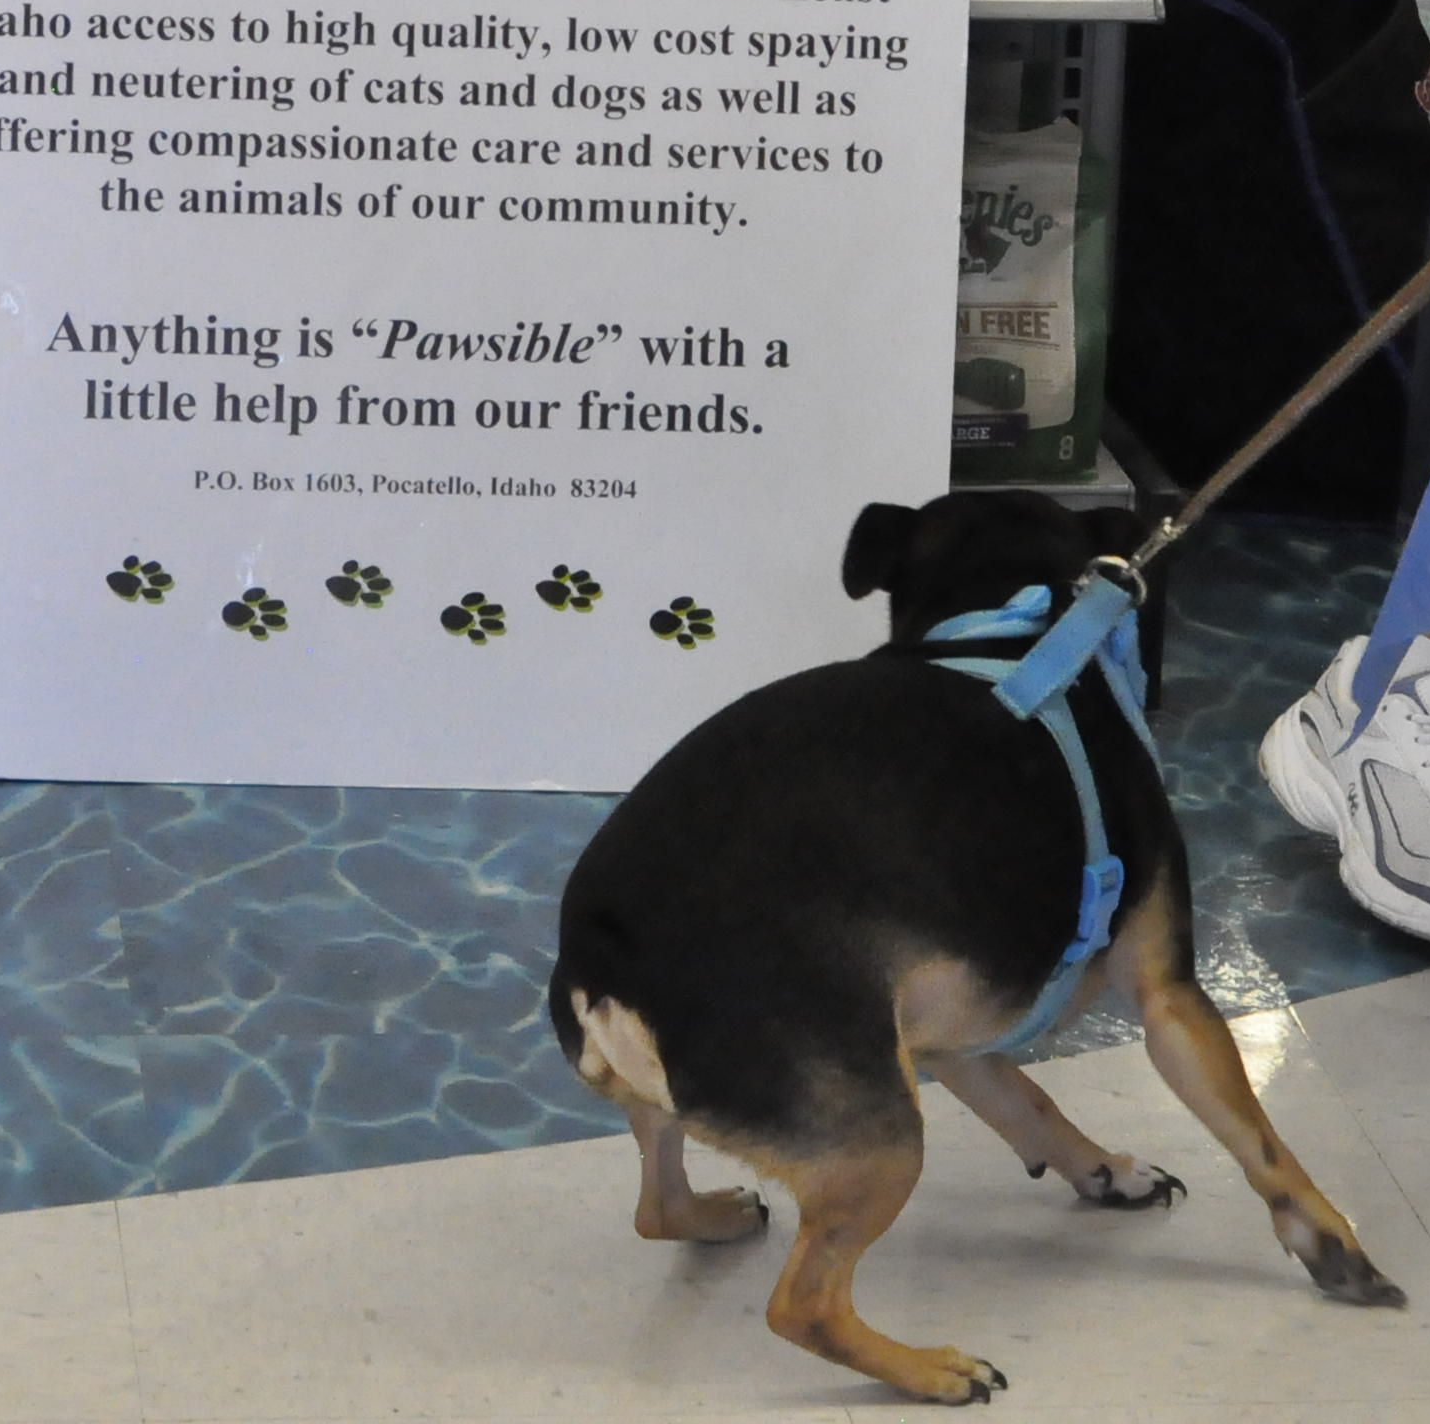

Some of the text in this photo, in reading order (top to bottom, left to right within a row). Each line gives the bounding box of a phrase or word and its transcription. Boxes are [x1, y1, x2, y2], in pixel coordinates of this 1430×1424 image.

[87, 15, 215, 42] access
[231, 12, 269, 43] to
[286, 10, 375, 55] high
[392, 15, 551, 60] quality,
[567, 17, 638, 53] low
[654, 25, 734, 55] cost
[748, 25, 908, 71] spaying
[92, 66, 295, 111] neutering
[310, 68, 354, 102] of
[364, 74, 444, 105] cats
[460, 74, 536, 107] and
[552, 75, 645, 120] dogs
[662, 87, 702, 112] as
[718, 80, 799, 114] well
[815, 91, 856, 116] as
[149, 125, 457, 167] compassionate
[472, 139, 560, 165] care
[576, 134, 651, 167] and
[668, 136, 829, 172] services
[845, 142, 883, 174] to
[100, 178, 747, 236] the animals of our community.
[46, 312, 789, 368] Anything is “Pawsible” with a
[980, 310, 1051, 340] FREE
[85, 379, 762, 436] little help from our friends.
[195, 471, 636, 498] P.O. Box 1603, Pocatello, Idaho 83204
